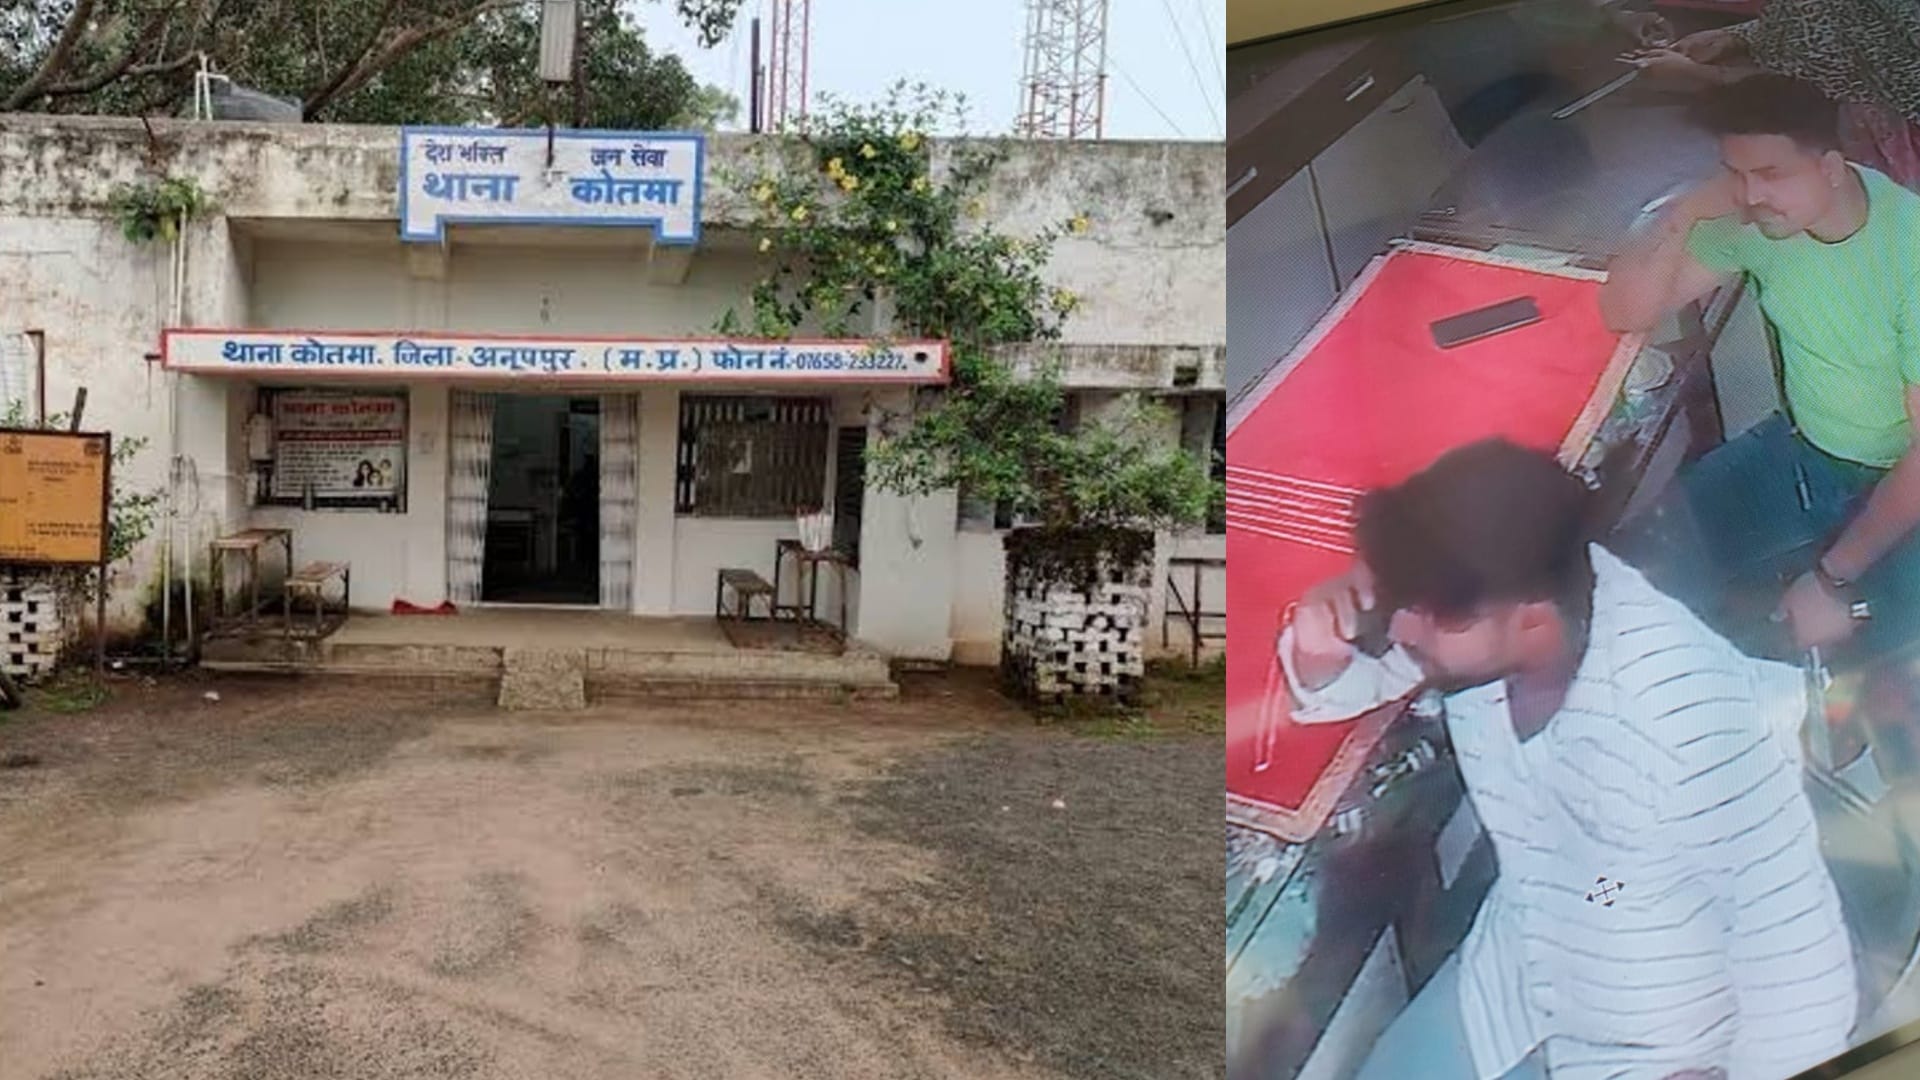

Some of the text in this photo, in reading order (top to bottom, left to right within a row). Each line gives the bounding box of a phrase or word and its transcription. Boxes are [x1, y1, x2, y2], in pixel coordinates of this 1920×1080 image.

[425, 139, 453, 165] देश
[590, 148, 626, 167] जन
[630, 143, 668, 167] सेवा
[422, 168, 684, 206] थाना कोतमा
[222, 340, 285, 363] थाना
[712, 344, 765, 370] फोन
